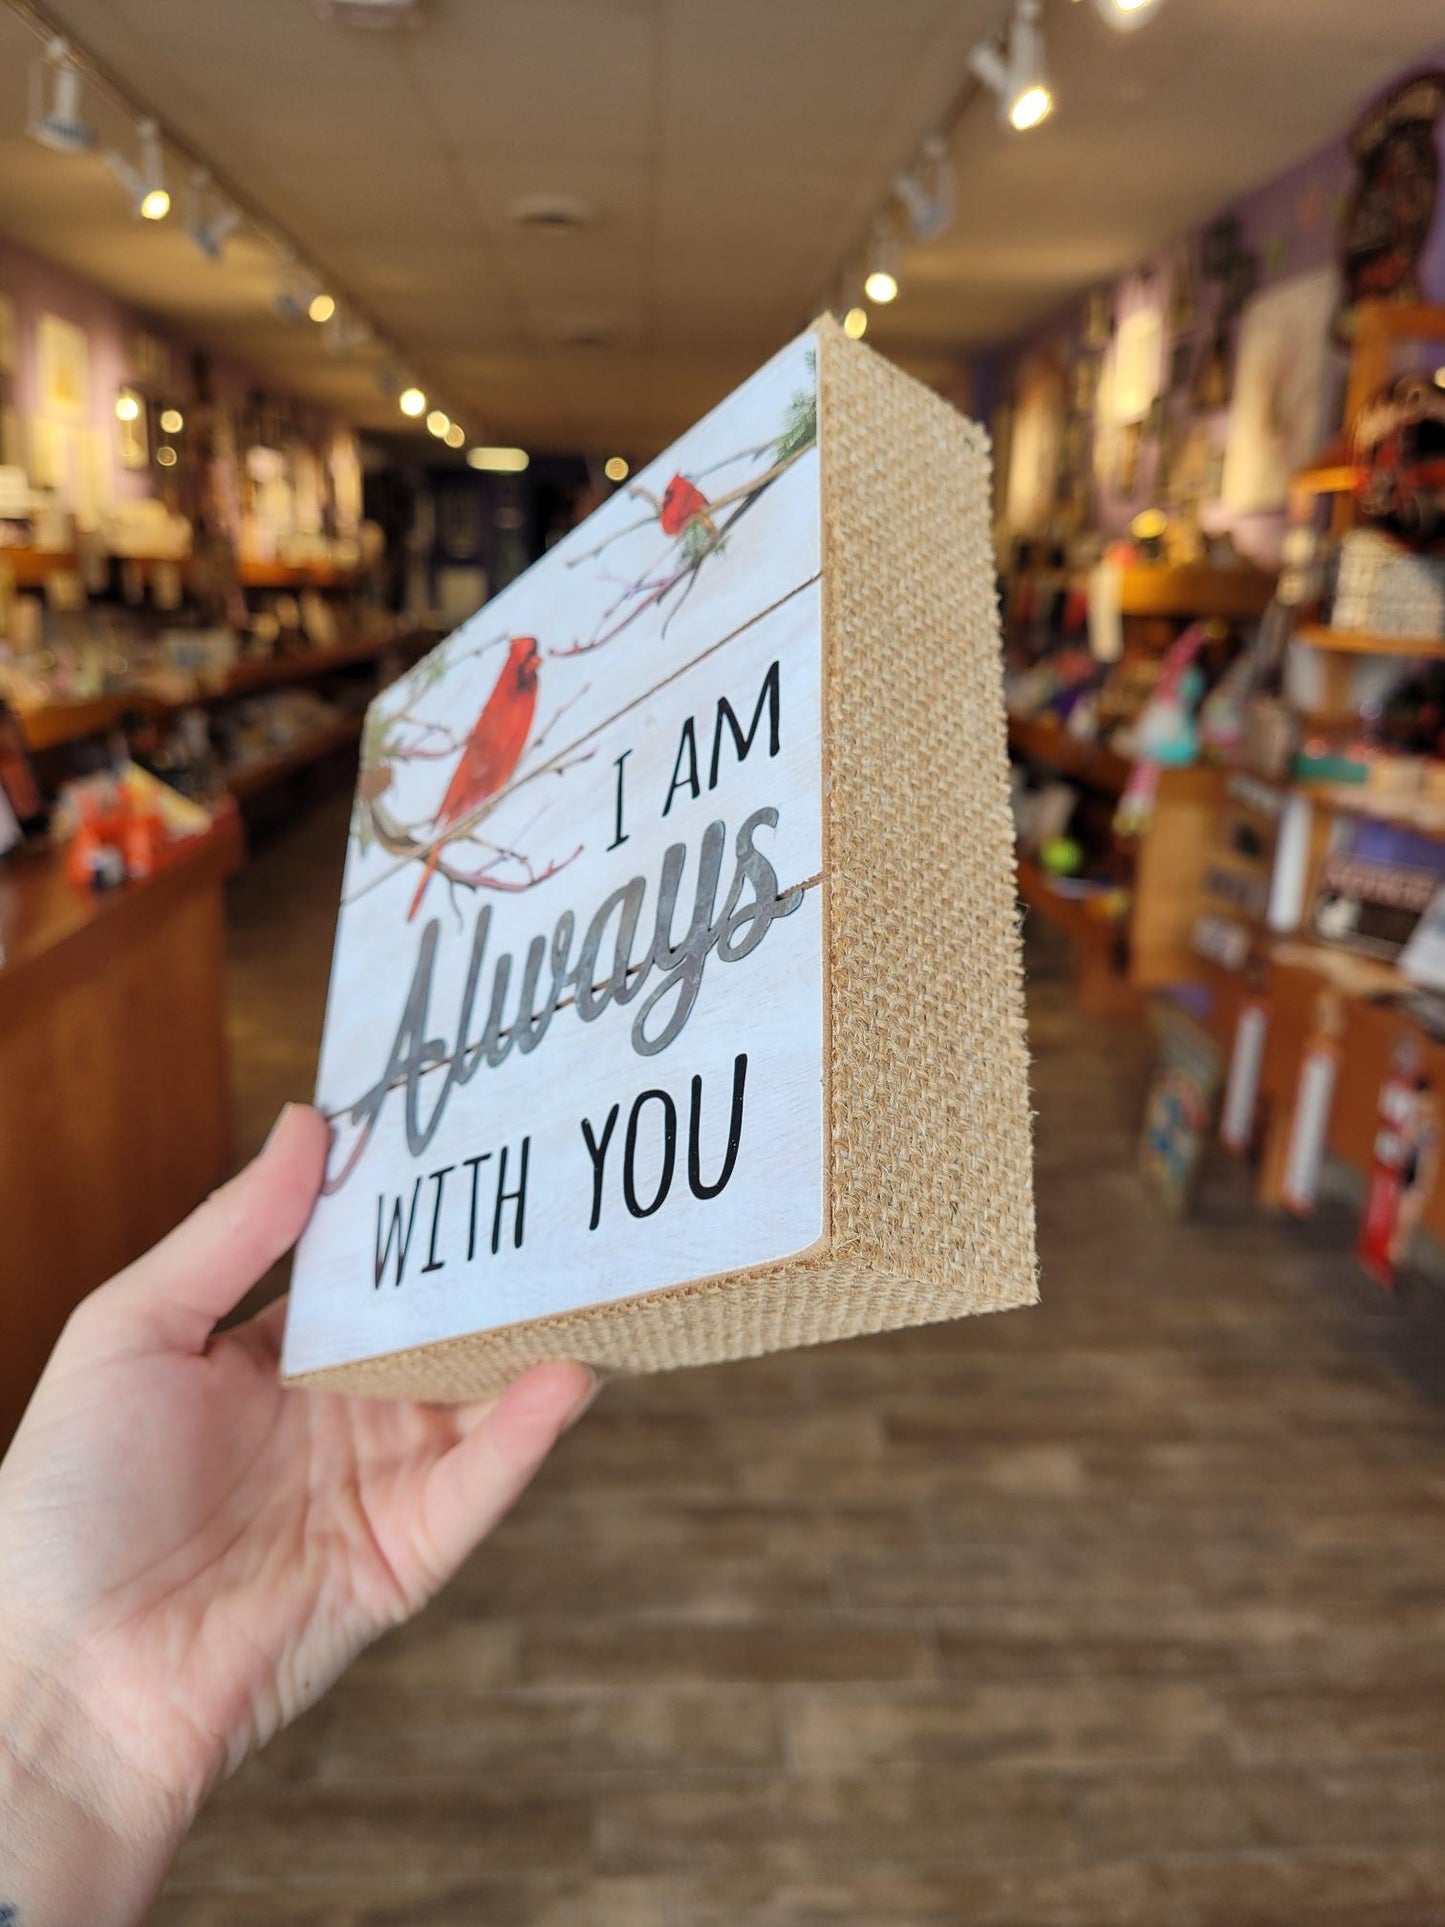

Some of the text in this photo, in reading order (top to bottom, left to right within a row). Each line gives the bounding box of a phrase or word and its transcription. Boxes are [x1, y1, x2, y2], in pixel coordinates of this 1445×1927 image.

[607, 659, 781, 852] I AM
[316, 806, 805, 1196] Always
[373, 1052, 749, 1290] WITH YOU
